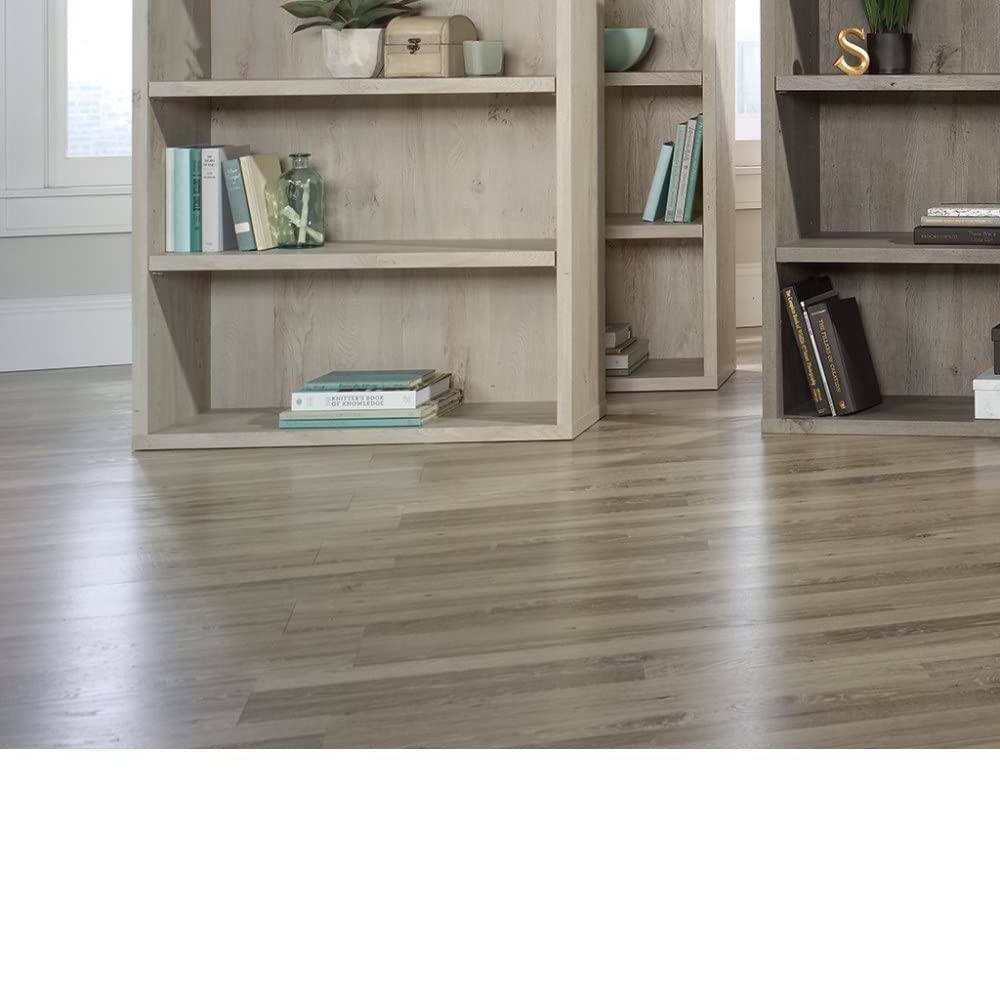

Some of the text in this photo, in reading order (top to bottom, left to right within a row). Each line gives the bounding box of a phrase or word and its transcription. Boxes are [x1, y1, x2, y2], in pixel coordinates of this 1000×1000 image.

[833, 26, 870, 74] S
[818, 319, 826, 331] THE
[821, 331, 832, 354] PILLARS
[830, 362, 841, 393] CREATION
